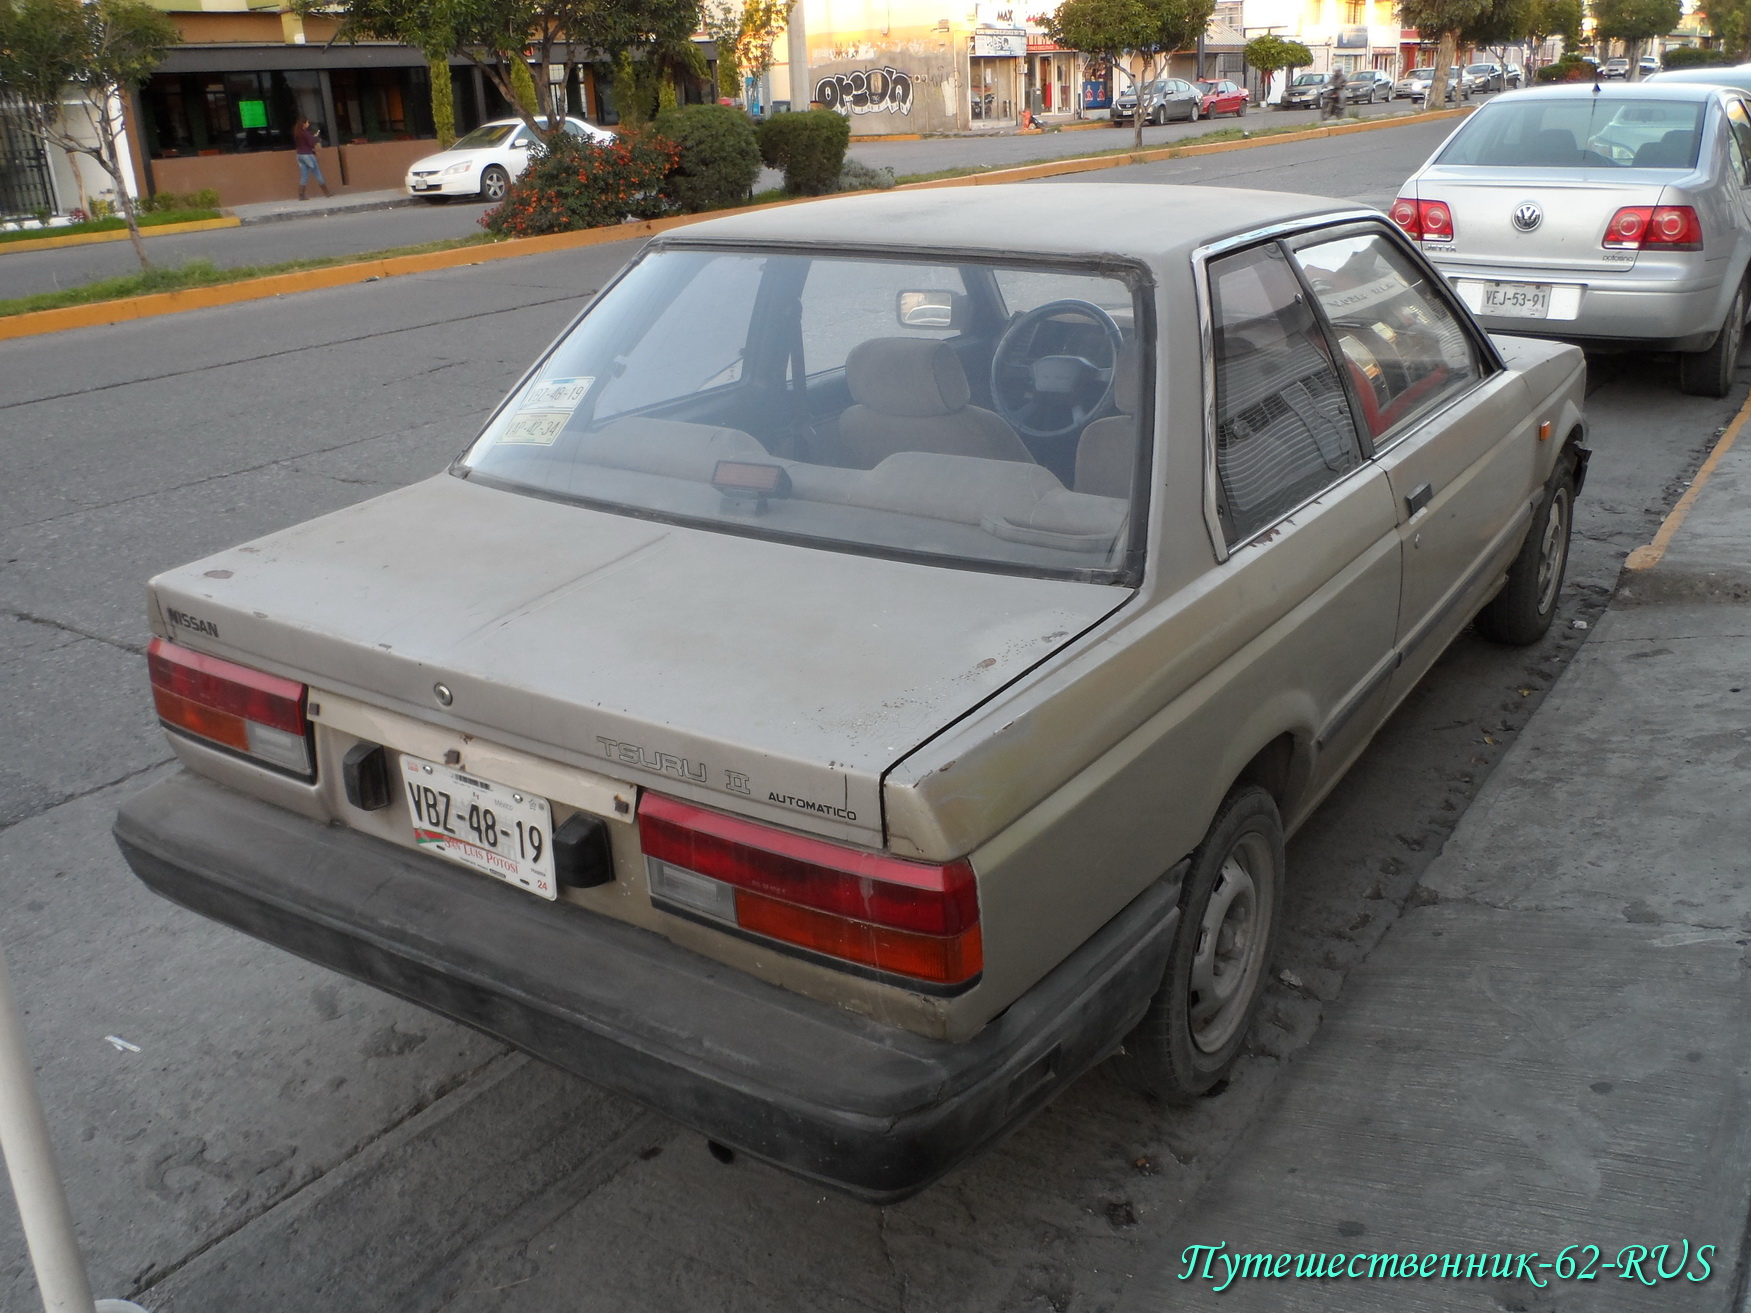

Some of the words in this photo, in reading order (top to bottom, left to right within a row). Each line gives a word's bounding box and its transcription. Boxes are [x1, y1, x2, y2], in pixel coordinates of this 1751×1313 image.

[1485, 290, 1546, 309] VEJ-53-91
[167, 607, 219, 638] NISSAN
[596, 736, 707, 783] TSURU
[724, 769, 751, 794] II
[768, 791, 857, 821] AUTOMATICO
[408, 781, 543, 865] VBZ-48-19
[443, 836, 462, 852] SAN
[464, 843, 484, 861] LUIS
[537, 880, 548, 891] 24
